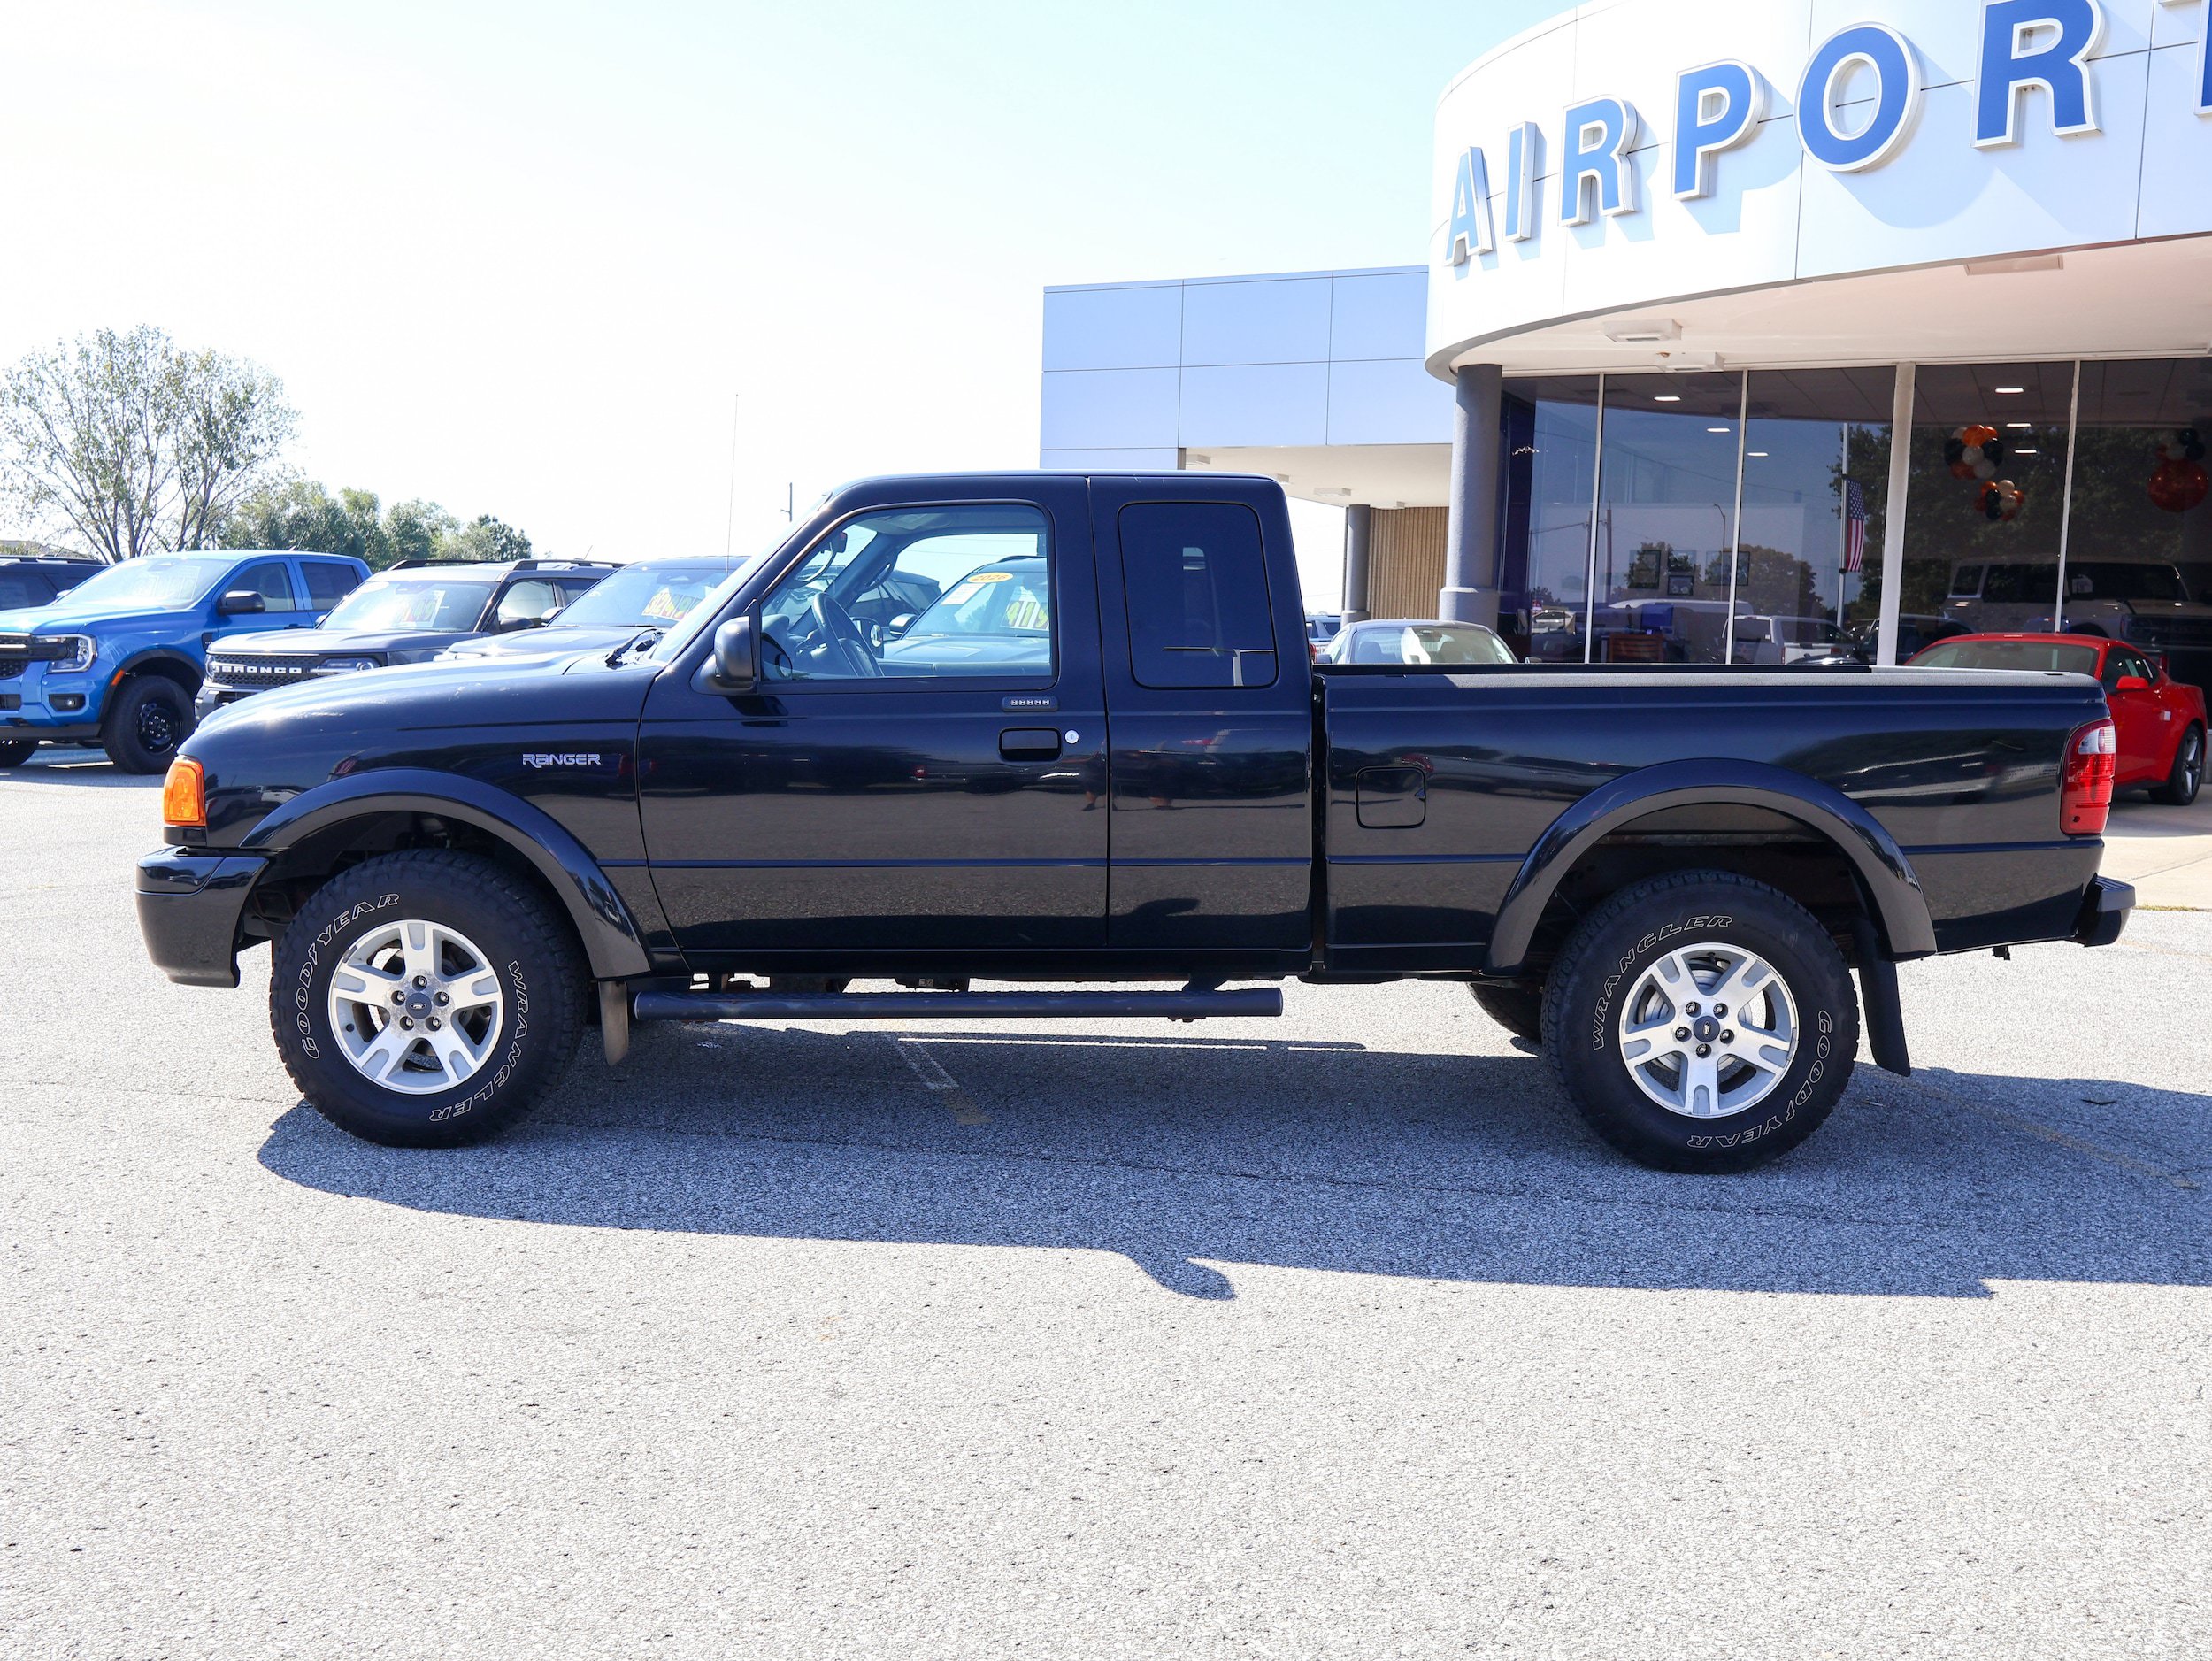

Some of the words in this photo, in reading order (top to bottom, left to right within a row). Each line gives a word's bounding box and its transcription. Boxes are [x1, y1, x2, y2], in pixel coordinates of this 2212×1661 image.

[221, 665, 303, 674] BRONCO
[522, 753, 602, 769] RANGER
[295, 893, 401, 1060] GOODYEAR
[429, 959, 530, 1123] WRANGLER
[1592, 914, 1734, 1051] WRANGLER
[1686, 1009, 1833, 1149] GOODYEAR
